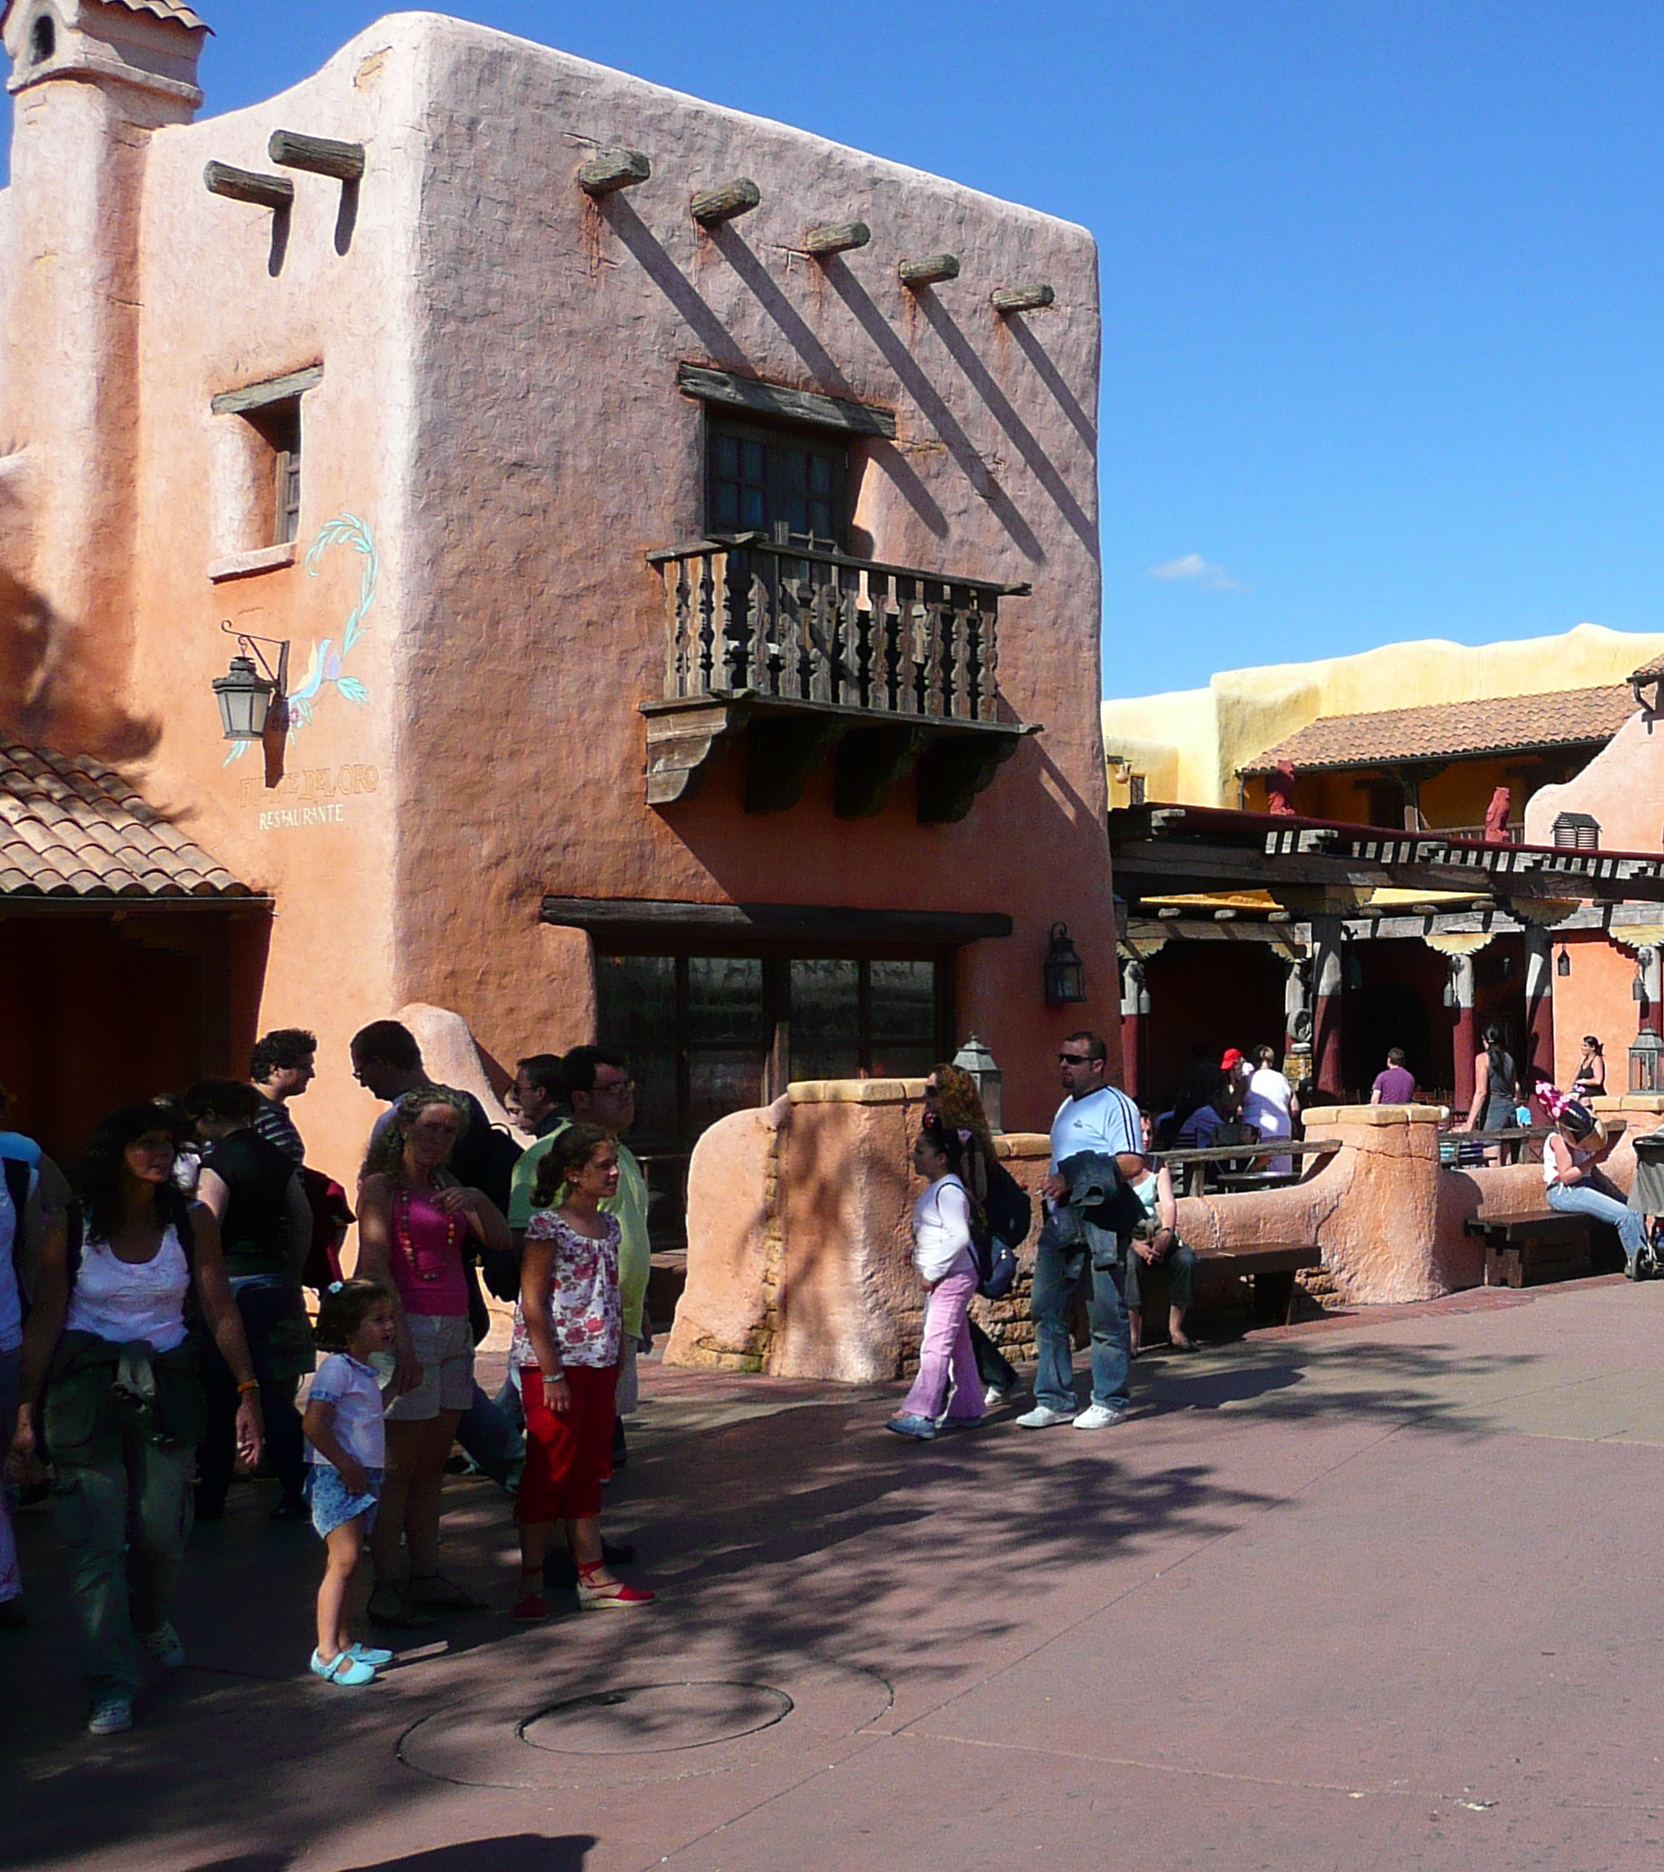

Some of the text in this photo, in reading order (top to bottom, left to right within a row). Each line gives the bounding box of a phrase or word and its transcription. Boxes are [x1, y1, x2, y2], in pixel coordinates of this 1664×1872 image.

[240, 764, 380, 807] FUNTE DEL ORO
[259, 803, 345, 830] RESTAURANTE
